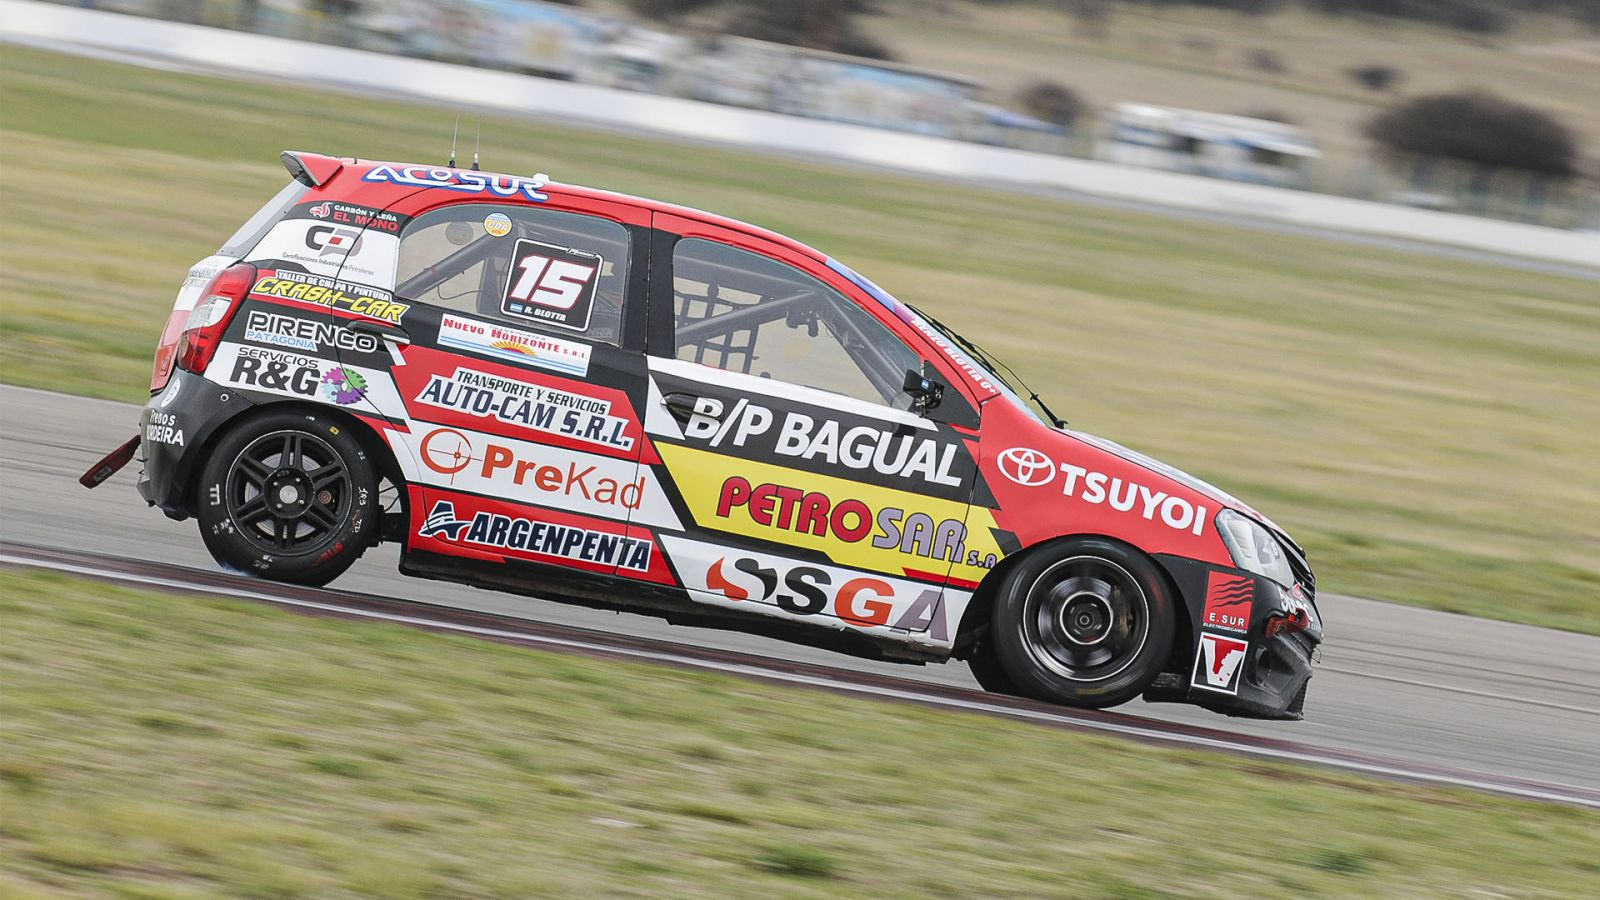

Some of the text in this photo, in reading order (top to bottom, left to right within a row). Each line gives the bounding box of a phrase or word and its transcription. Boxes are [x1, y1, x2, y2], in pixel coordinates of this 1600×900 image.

[333, 204, 367, 216] CARBÓN
[333, 211, 399, 231] EL MONO
[254, 278, 407, 322] CRASH-CAR
[277, 271, 306, 283] TALLER
[308, 276, 318, 285] DE
[346, 284, 354, 292] Y
[354, 285, 390, 301] PINTURA
[509, 253, 596, 310] 15
[249, 312, 376, 352] PIRENCO
[442, 318, 485, 335] NUEVO
[491, 328, 560, 353] HORIZONTE
[534, 308, 567, 322] BLOTTA
[238, 347, 319, 369] SERVICIOS
[246, 330, 317, 349] PATAGONIA
[230, 356, 321, 396] R&G
[457, 370, 608, 415] TRANSPORTE Y SERVICIOS
[421, 378, 630, 447] AUTO-CAM S.R.L.
[684, 396, 962, 487] B/P BAGUAL
[481, 444, 646, 510] PreKad
[716, 476, 968, 565] PETROSAR
[1059, 462, 1207, 537] TSUYOI
[466, 513, 651, 571] ARGENPENTA
